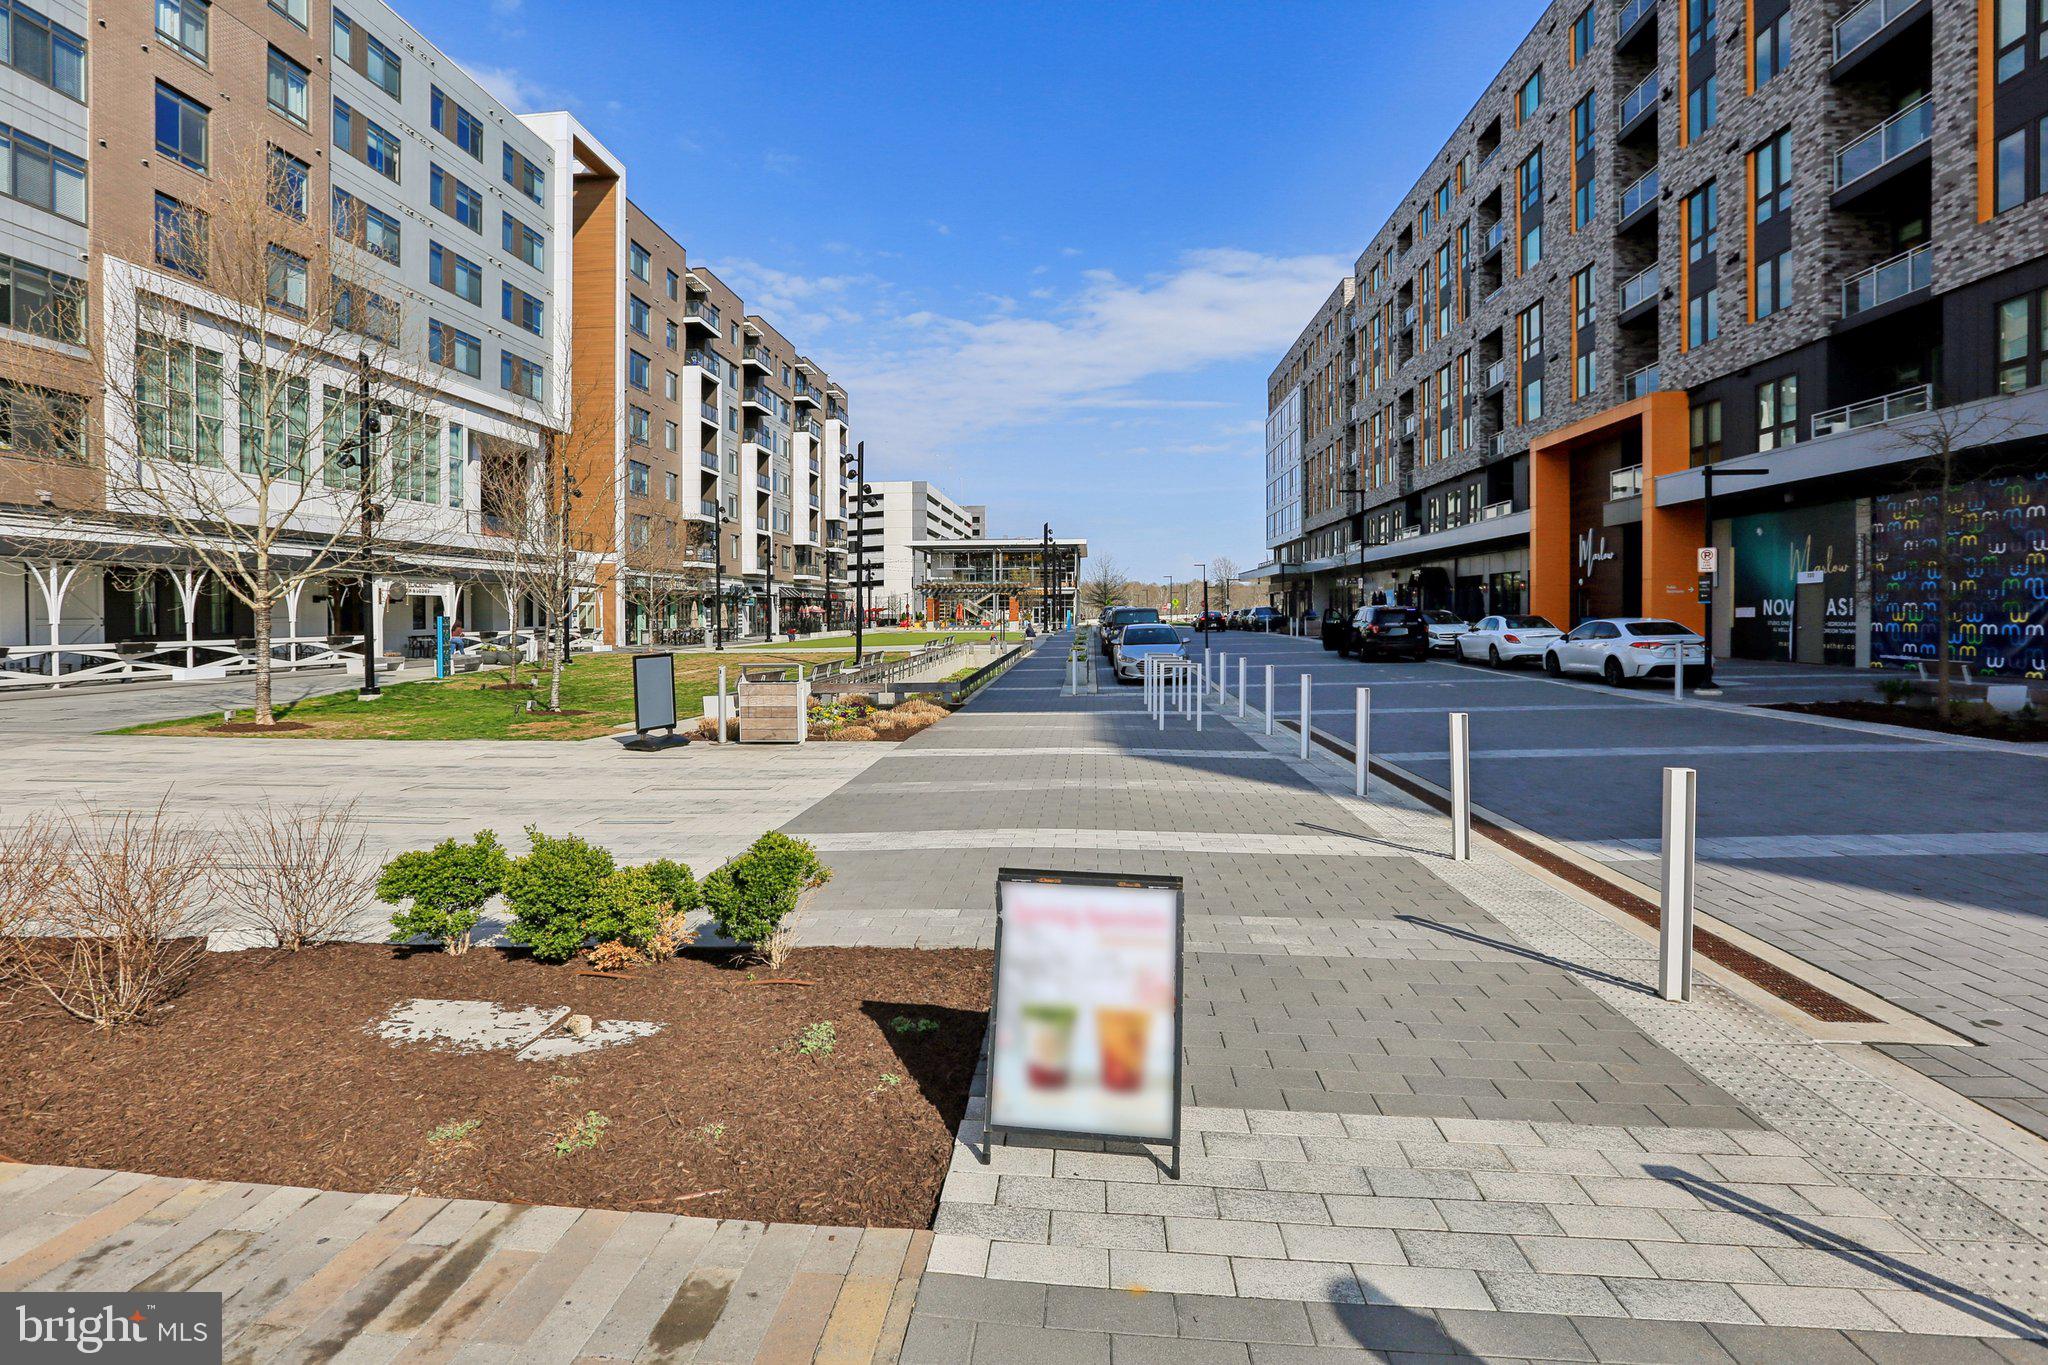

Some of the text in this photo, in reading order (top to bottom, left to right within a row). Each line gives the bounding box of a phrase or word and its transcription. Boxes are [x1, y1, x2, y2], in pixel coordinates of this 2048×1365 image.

[1579, 528, 1614, 577] Marlow
[1790, 534, 1850, 580] Marlow
[1825, 597, 1854, 616] ASI
